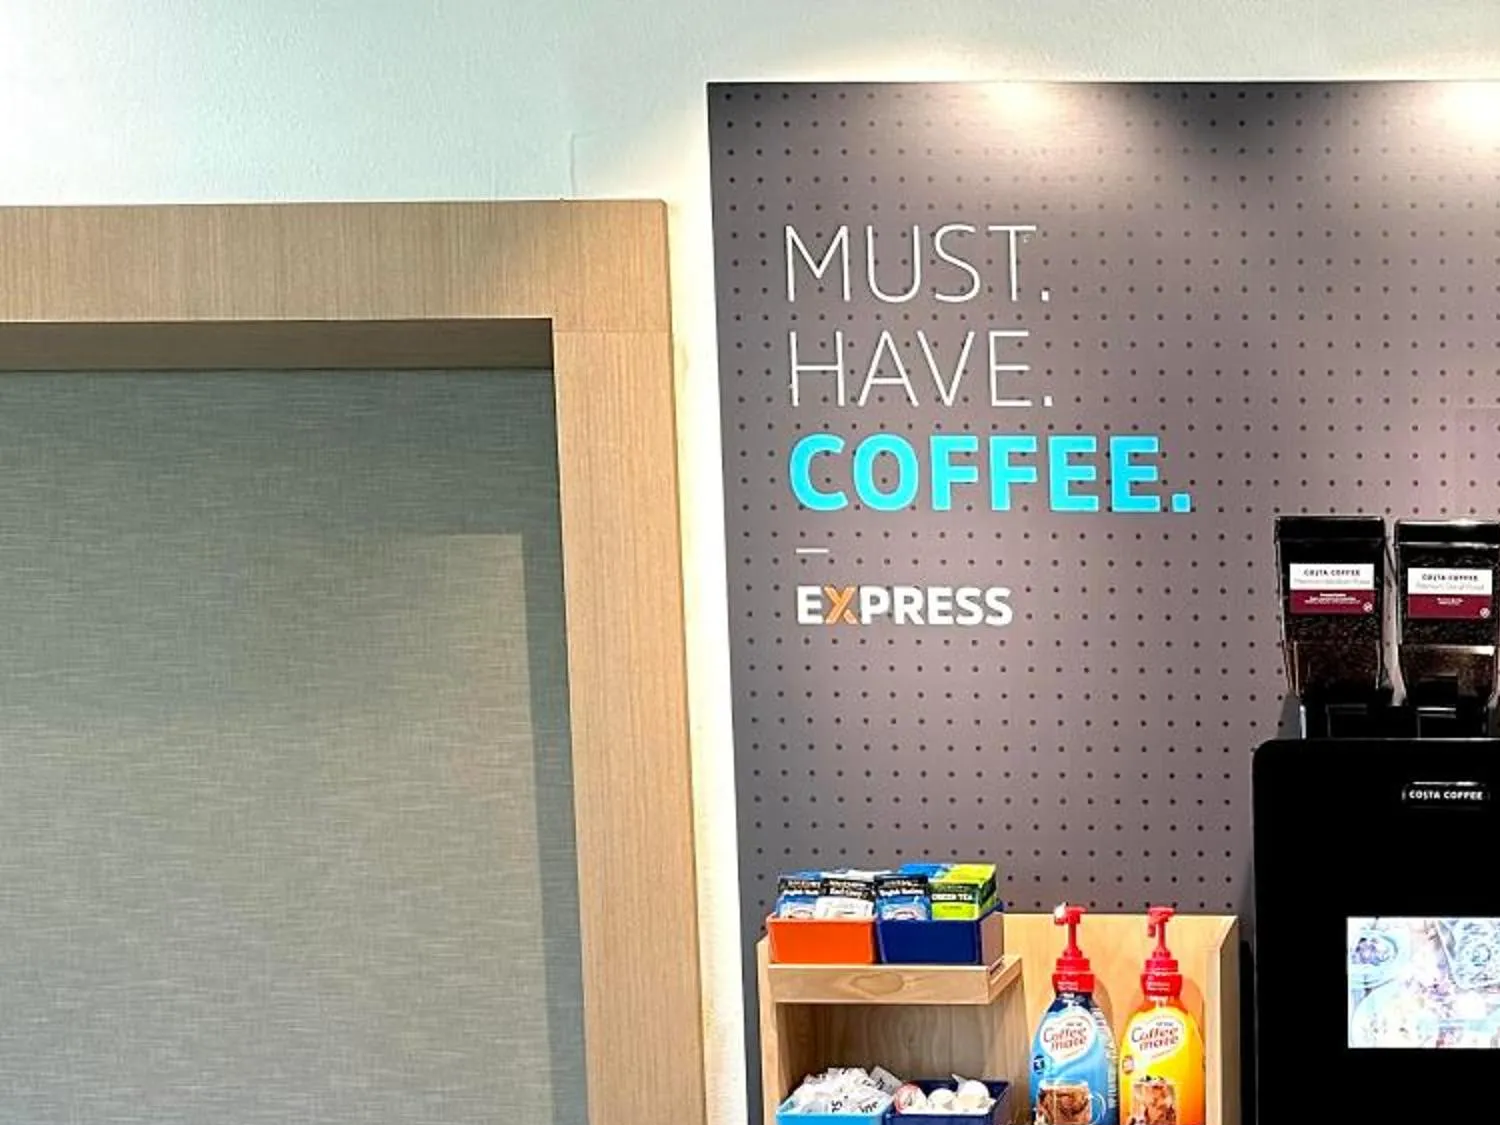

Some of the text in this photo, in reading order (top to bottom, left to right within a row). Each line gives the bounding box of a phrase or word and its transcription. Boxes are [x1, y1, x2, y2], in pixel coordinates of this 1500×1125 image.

[785, 224, 1050, 303] MUST.
[789, 330, 1053, 407] HAVE.
[788, 433, 1192, 513] COFFEE.
[796, 586, 1013, 625] EXPRESS
[1408, 789, 1483, 801] COSTA COFFEE
[1043, 1026, 1088, 1043] Coffee
[1131, 1026, 1179, 1043] Coffee
[1051, 1036, 1088, 1051] mate
[1139, 1037, 1179, 1051] mate
